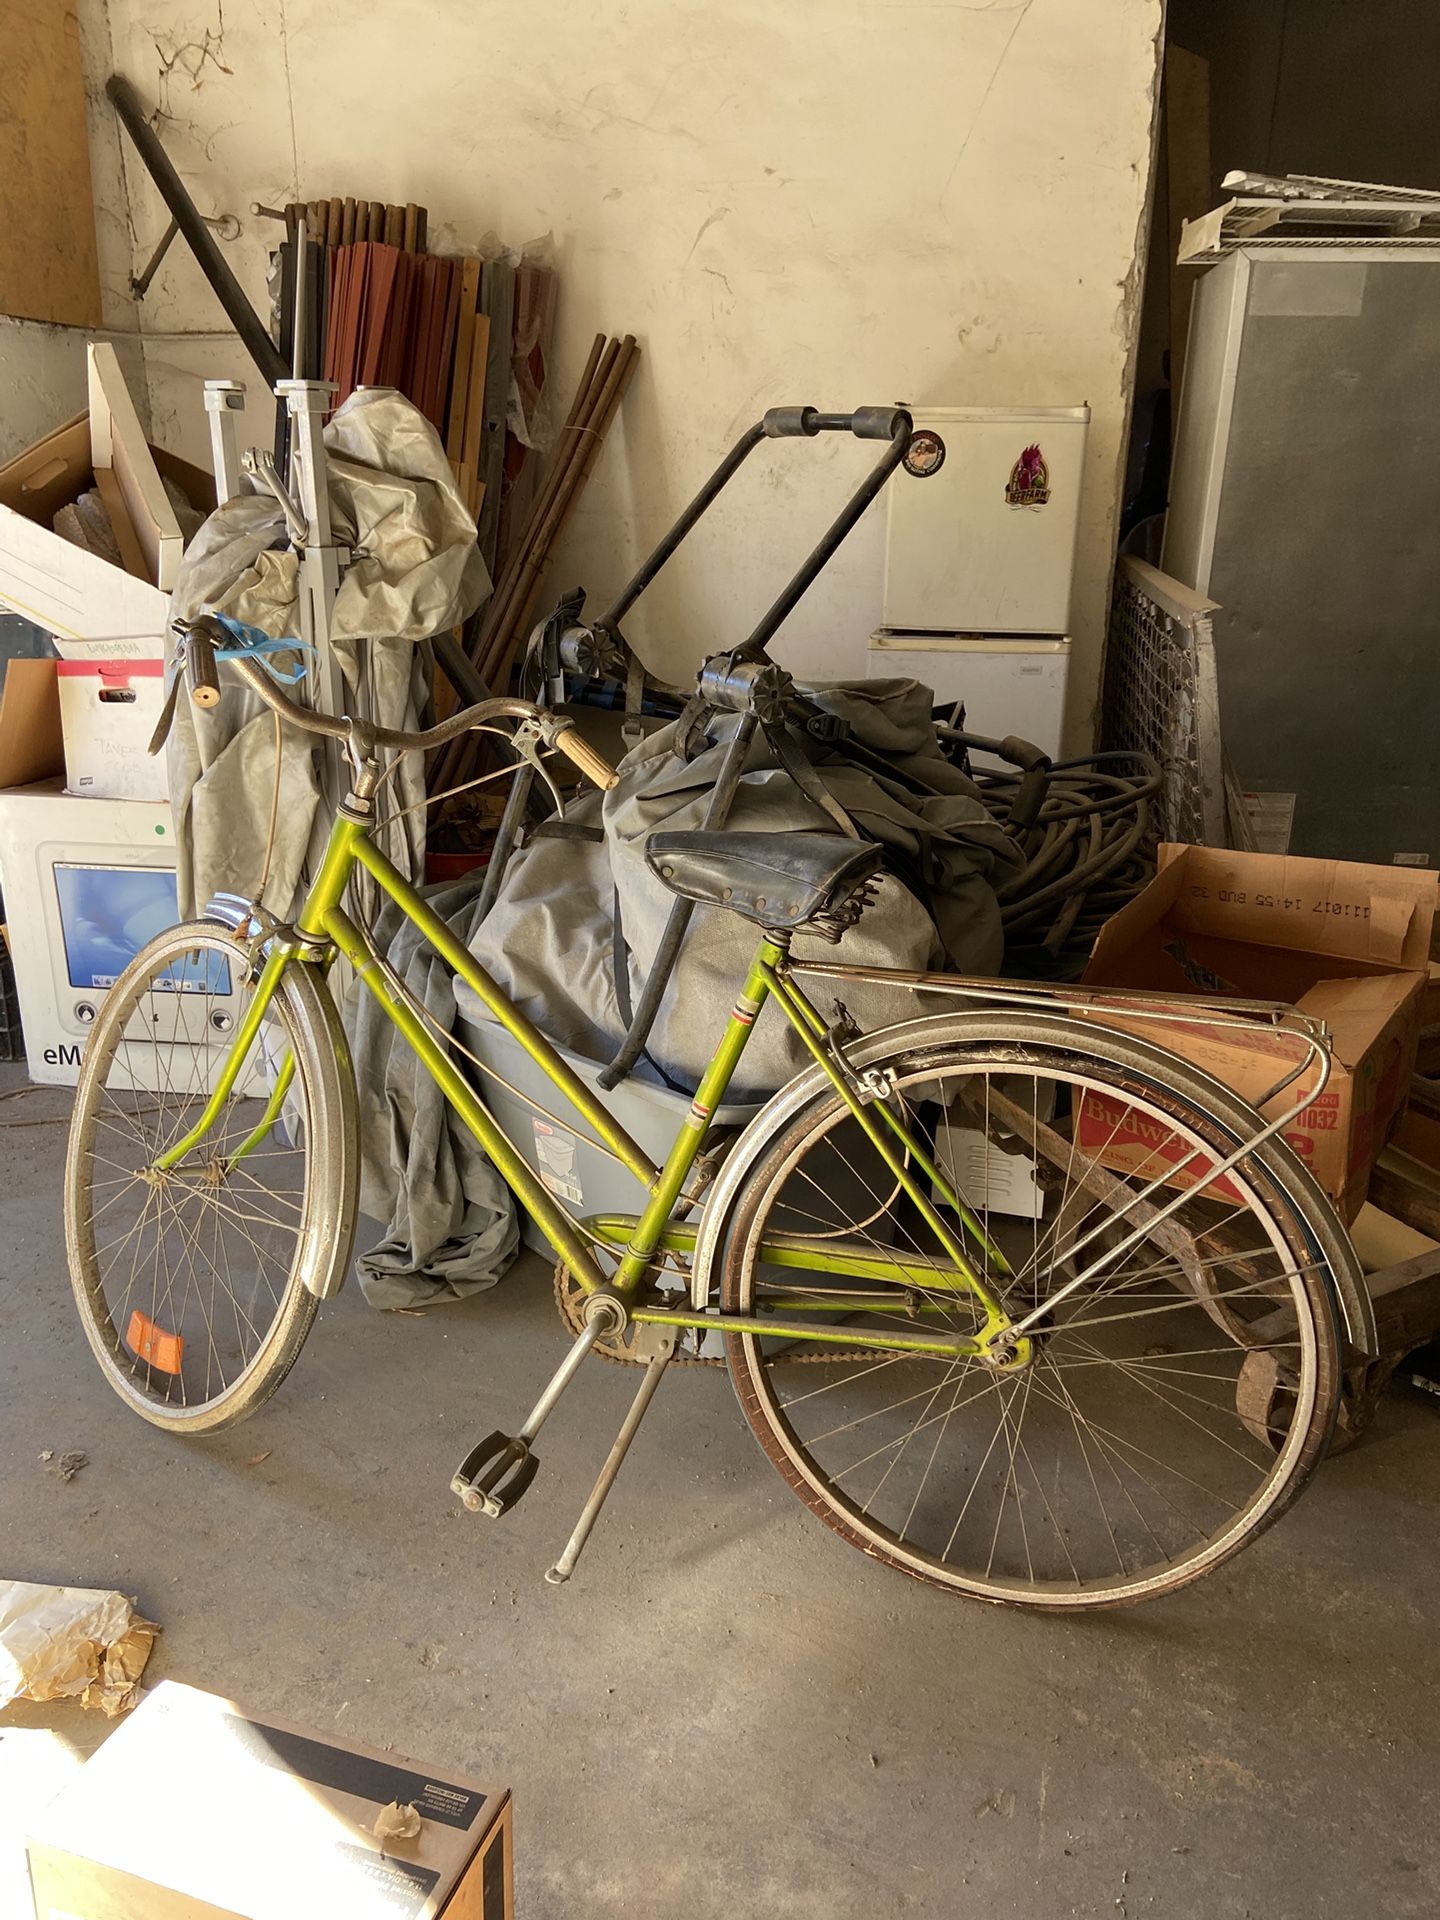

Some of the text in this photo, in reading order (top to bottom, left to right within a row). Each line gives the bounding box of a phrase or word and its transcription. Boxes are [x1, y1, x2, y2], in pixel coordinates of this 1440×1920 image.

[1191, 885, 1370, 919] 111017 14:55 BUD 32
